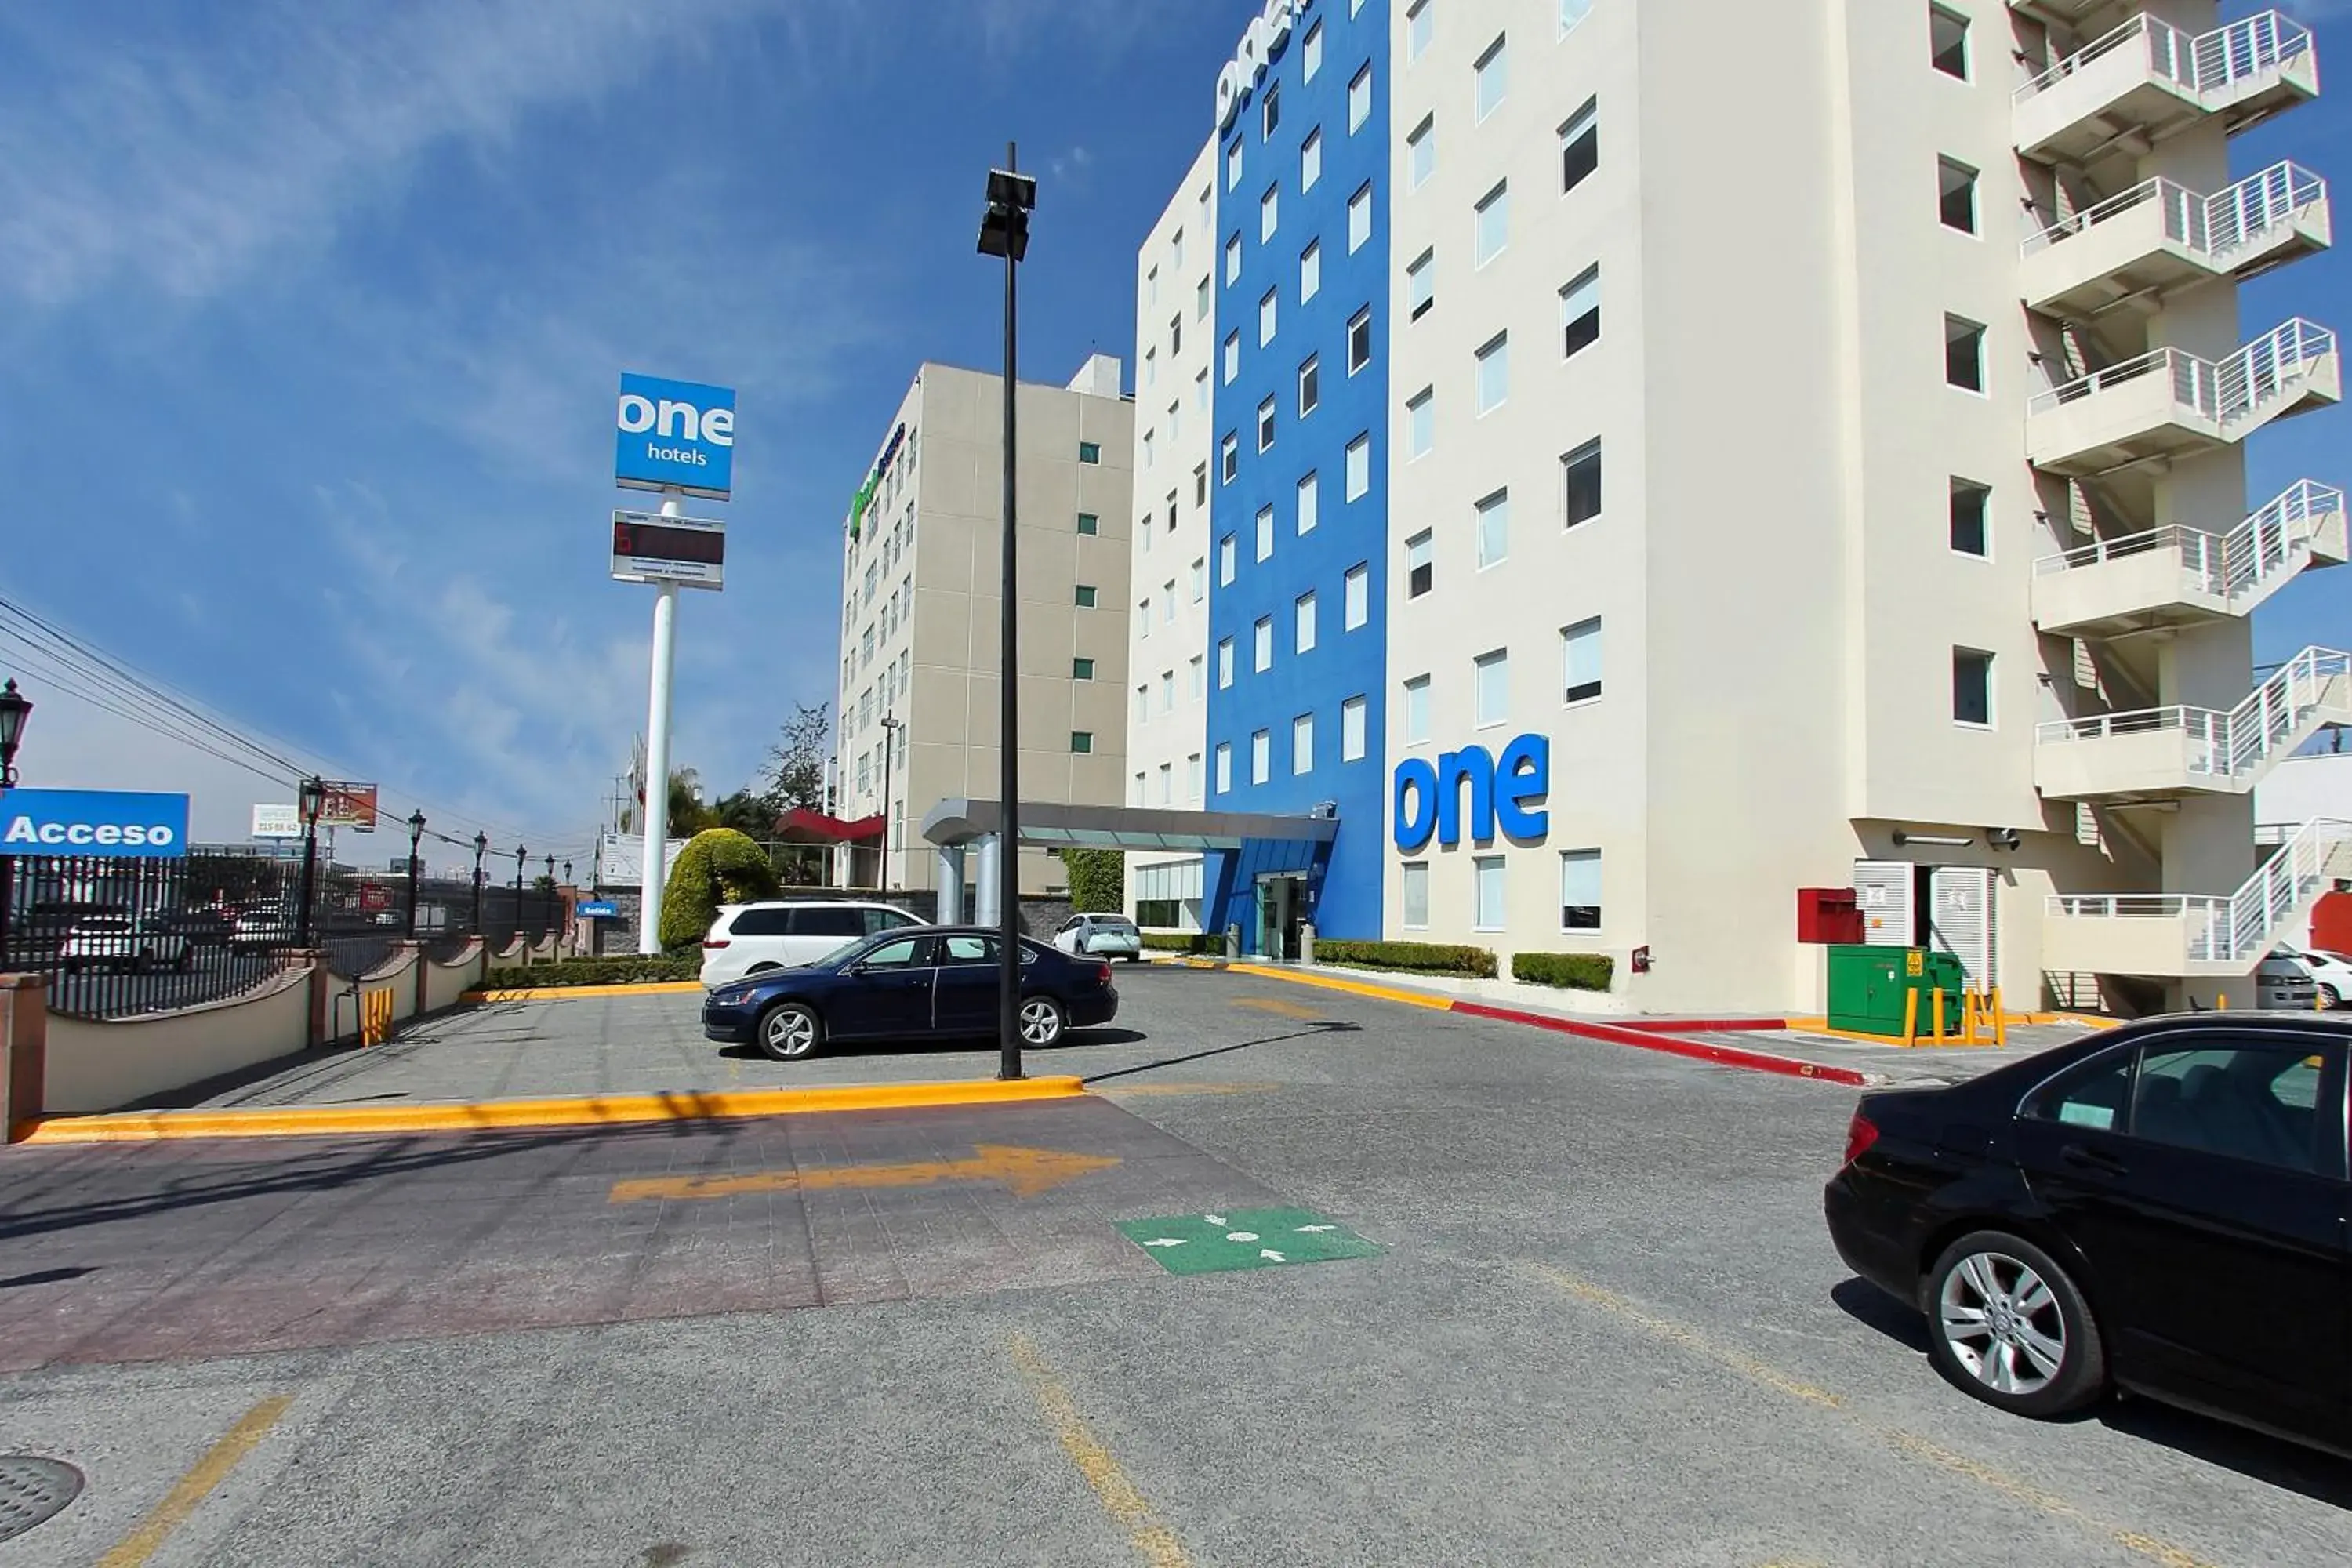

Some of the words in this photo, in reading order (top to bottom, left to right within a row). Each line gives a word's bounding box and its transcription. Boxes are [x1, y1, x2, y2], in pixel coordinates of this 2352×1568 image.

[618, 394, 735, 446] one
[648, 443, 707, 466] hotels
[1394, 733, 1550, 854] one
[5, 816, 174, 847] Acceso
